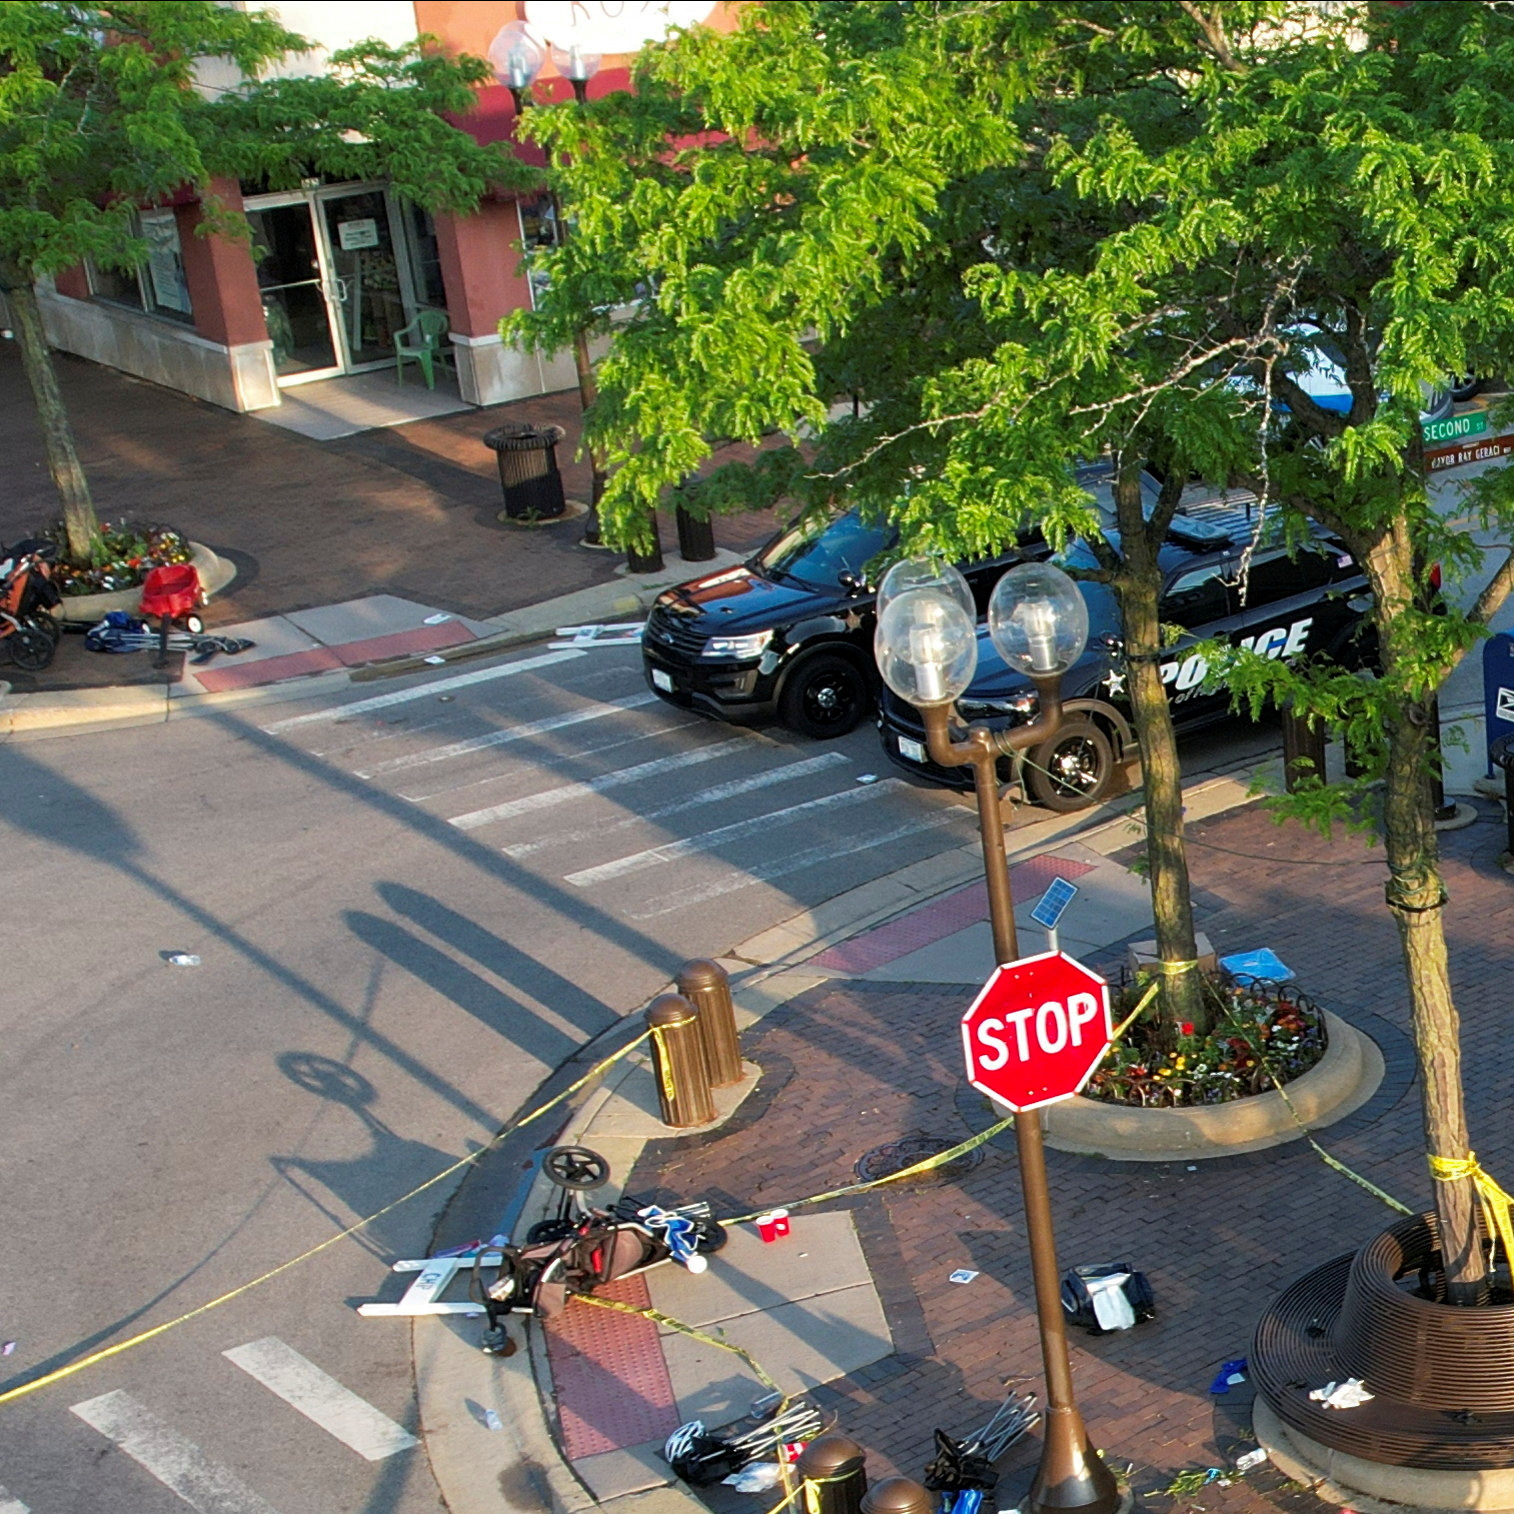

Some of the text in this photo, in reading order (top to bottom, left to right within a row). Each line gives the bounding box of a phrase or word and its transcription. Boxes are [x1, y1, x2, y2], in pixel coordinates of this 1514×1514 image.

[1423, 418, 1470, 441] SECOND
[1458, 451, 1472, 463] RAY
[977, 992, 1098, 1071] STOP
